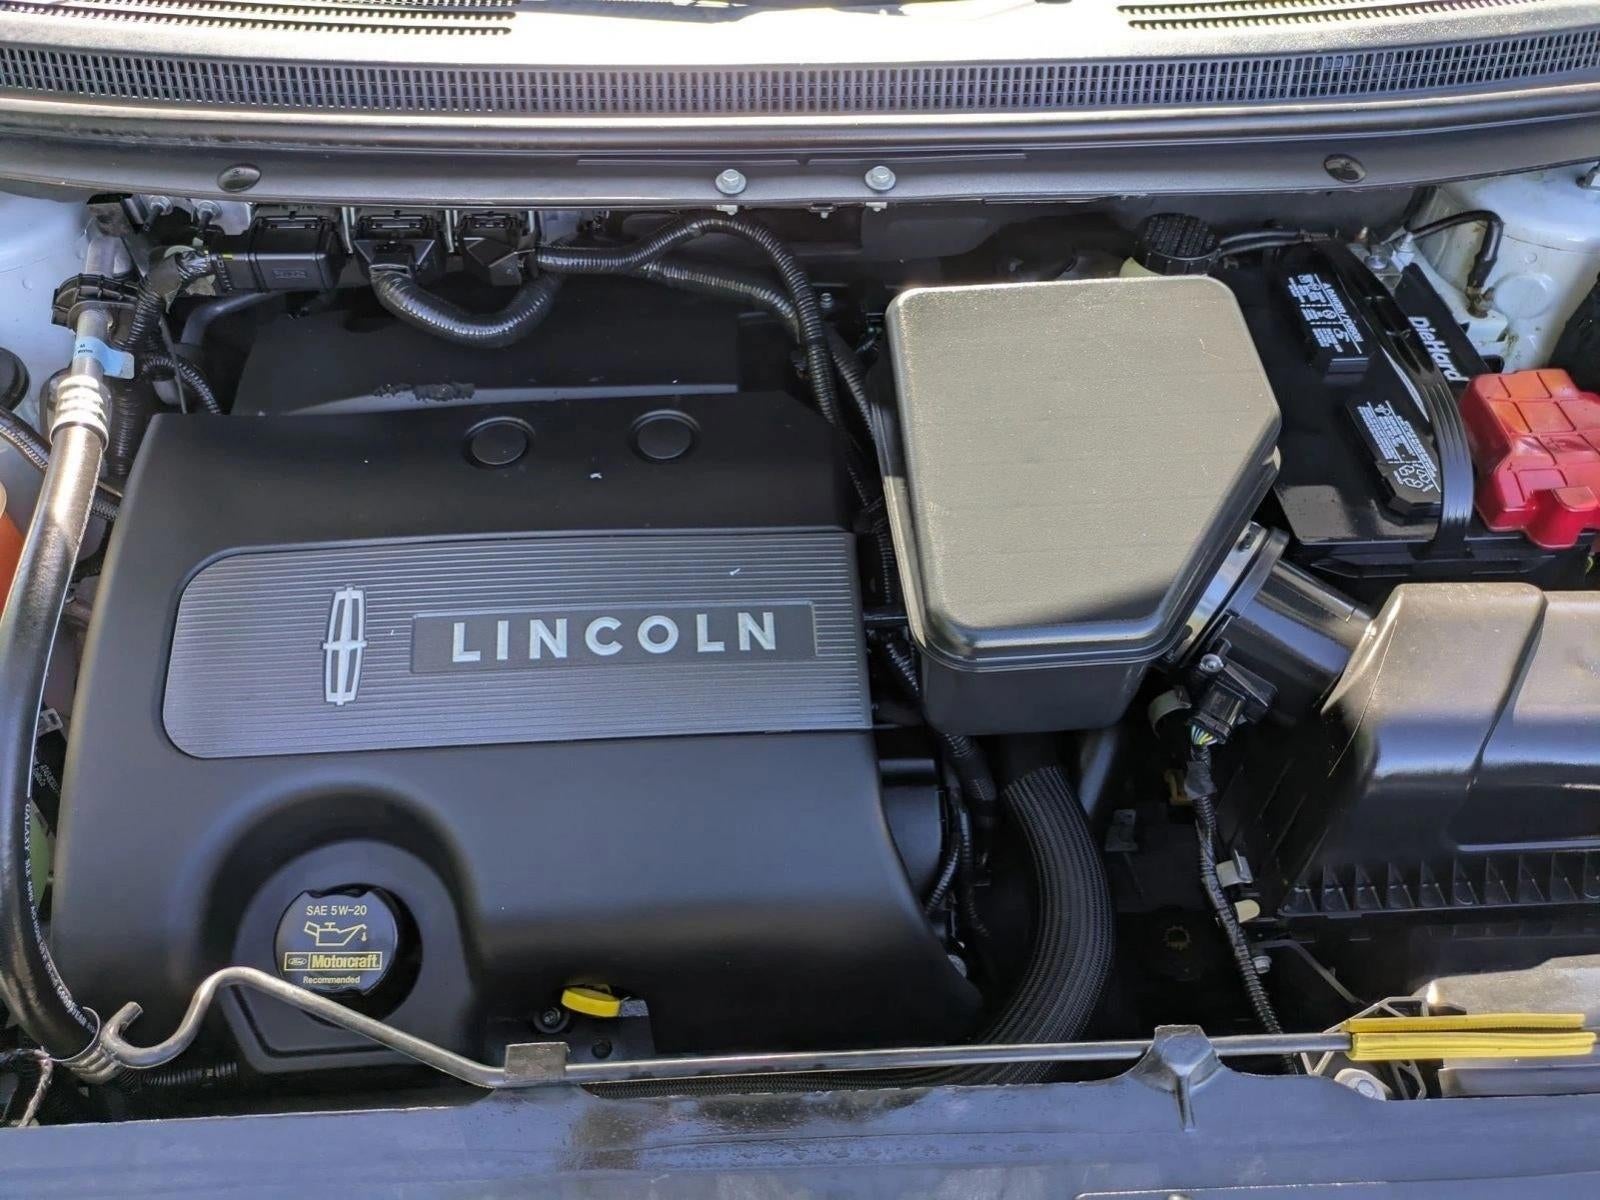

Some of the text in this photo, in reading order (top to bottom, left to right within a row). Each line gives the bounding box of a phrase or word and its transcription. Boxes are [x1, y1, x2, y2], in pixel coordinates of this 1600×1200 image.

[1408, 316, 1470, 381] DieHard
[452, 611, 777, 663] LINCOLN
[306, 905, 367, 916] SAE 5W-20
[312, 955, 376, 968] Motorcraft
[303, 976, 361, 984] Recommended
